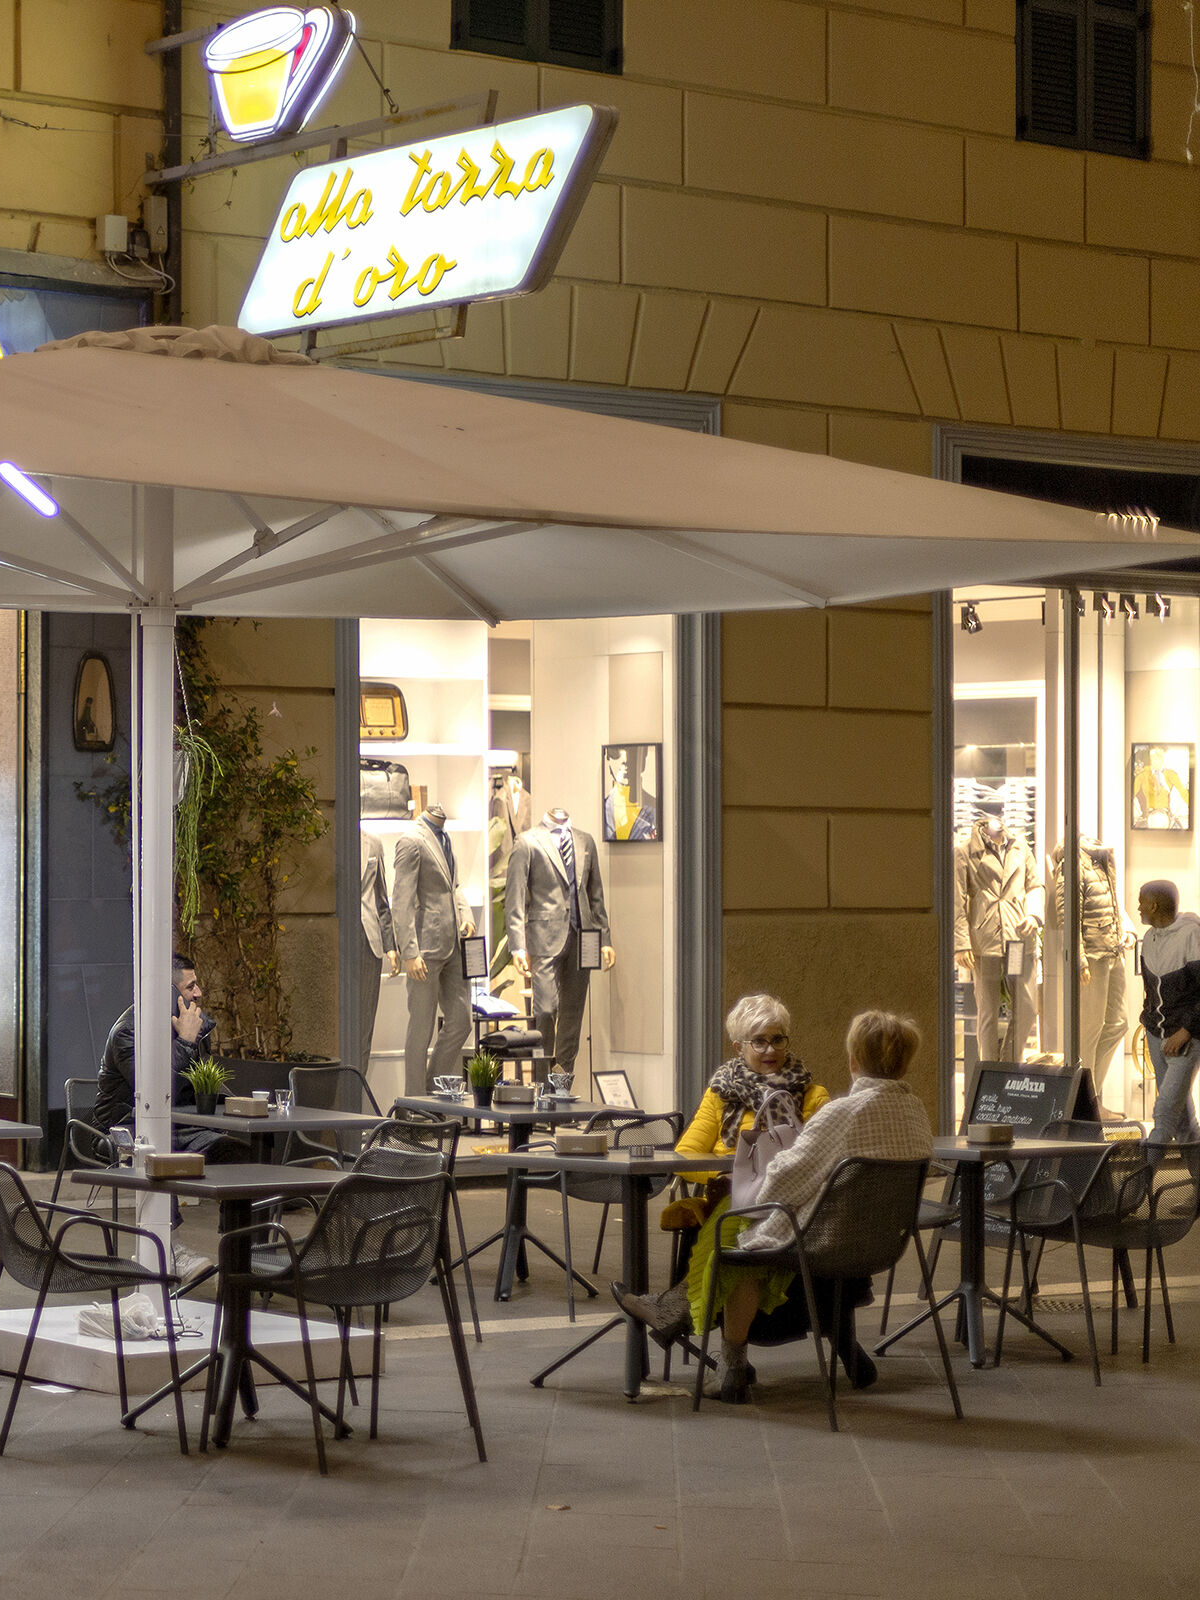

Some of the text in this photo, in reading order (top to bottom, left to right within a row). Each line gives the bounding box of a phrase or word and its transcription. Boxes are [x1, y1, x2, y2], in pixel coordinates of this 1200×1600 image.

[279, 138, 555, 243] alla tazza
[291, 244, 458, 318] d'oro
[1004, 1077, 1045, 1093] LAVAZZA
